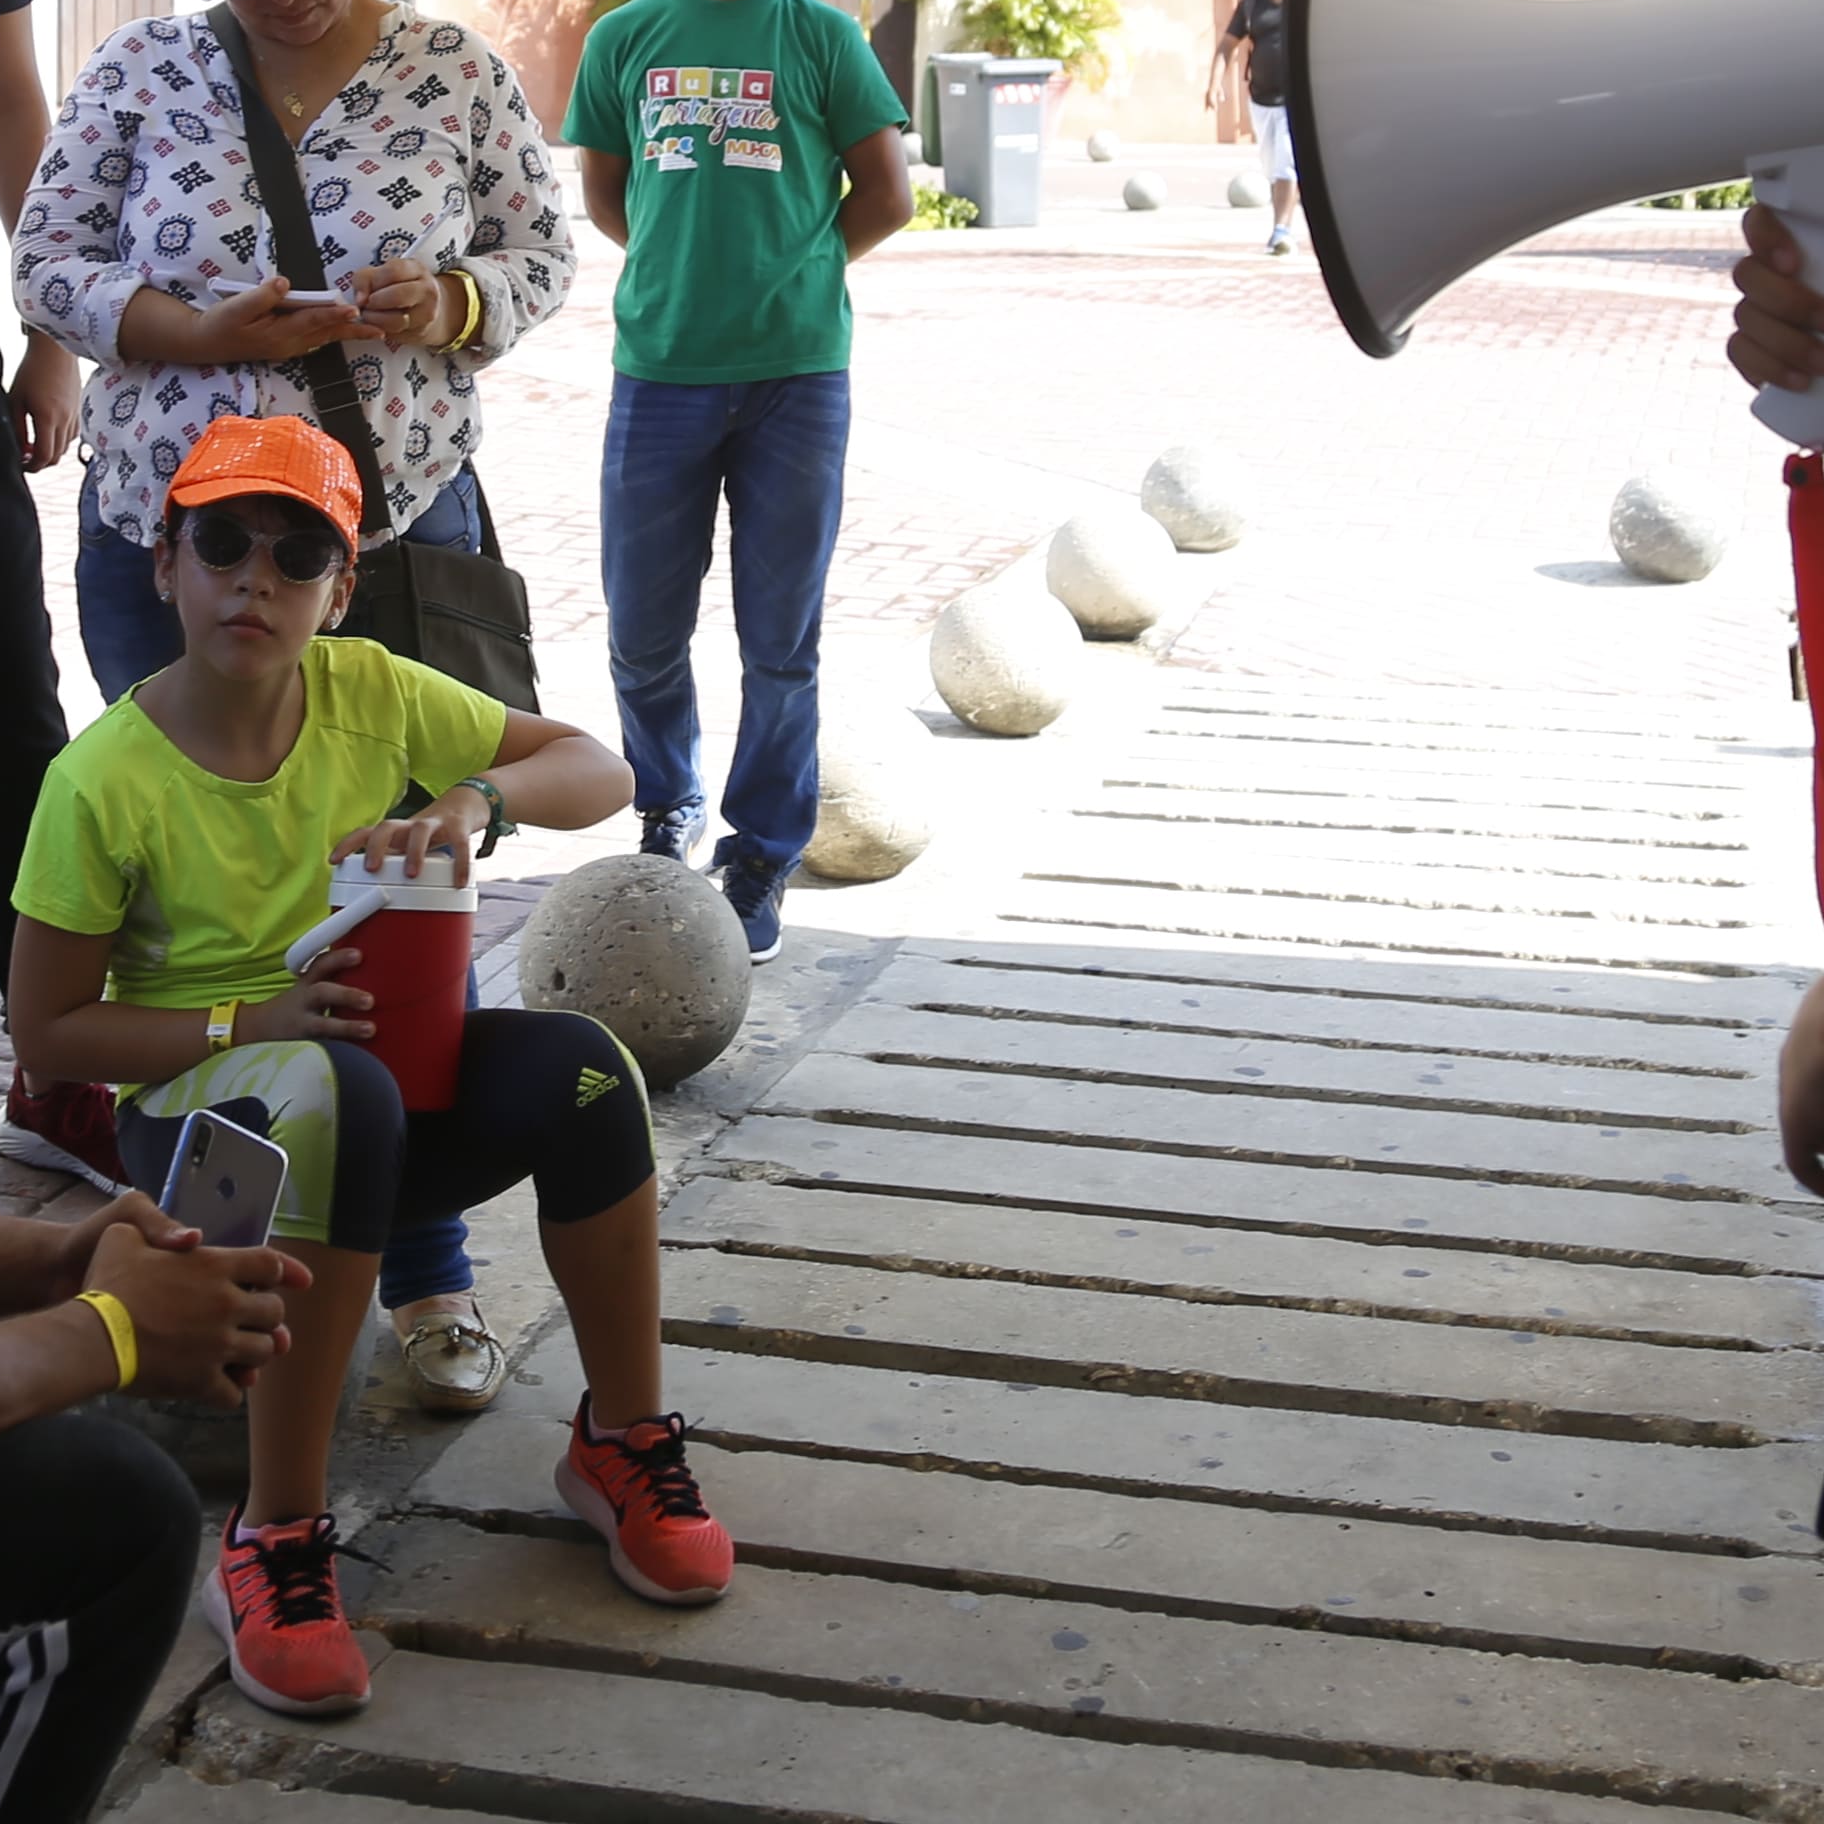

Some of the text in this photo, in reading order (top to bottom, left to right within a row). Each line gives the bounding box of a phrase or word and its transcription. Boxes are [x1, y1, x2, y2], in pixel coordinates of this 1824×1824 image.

[651, 74, 768, 97] Ruta
[640, 97, 780, 145] Cartagena
[576, 1076, 620, 1107] adidas
